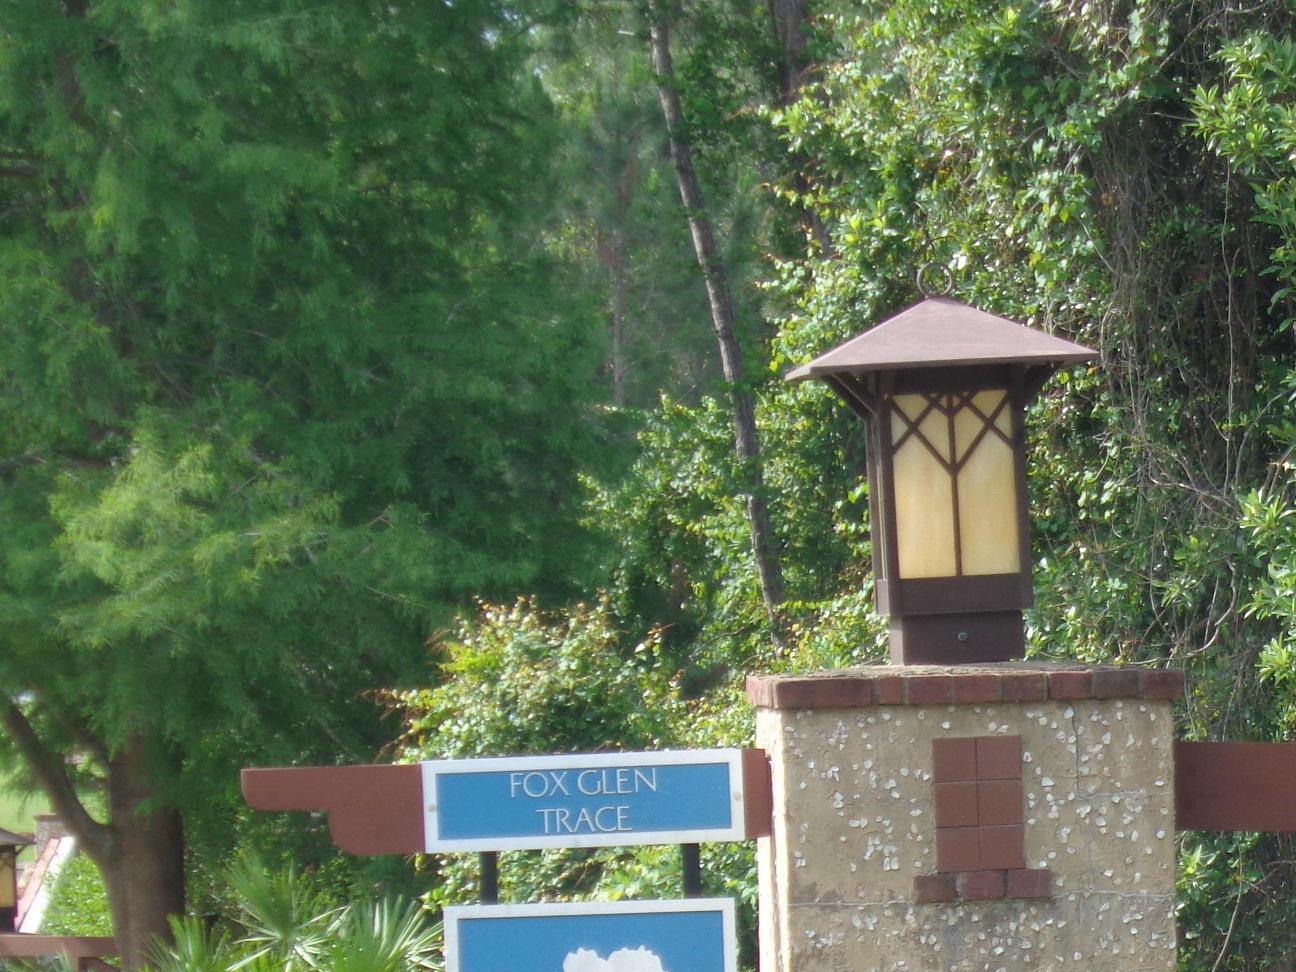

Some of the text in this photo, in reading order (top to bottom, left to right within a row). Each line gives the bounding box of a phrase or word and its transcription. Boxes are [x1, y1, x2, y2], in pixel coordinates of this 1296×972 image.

[510, 768, 657, 798] FOX GLEN
[536, 806, 633, 834] TRACE
